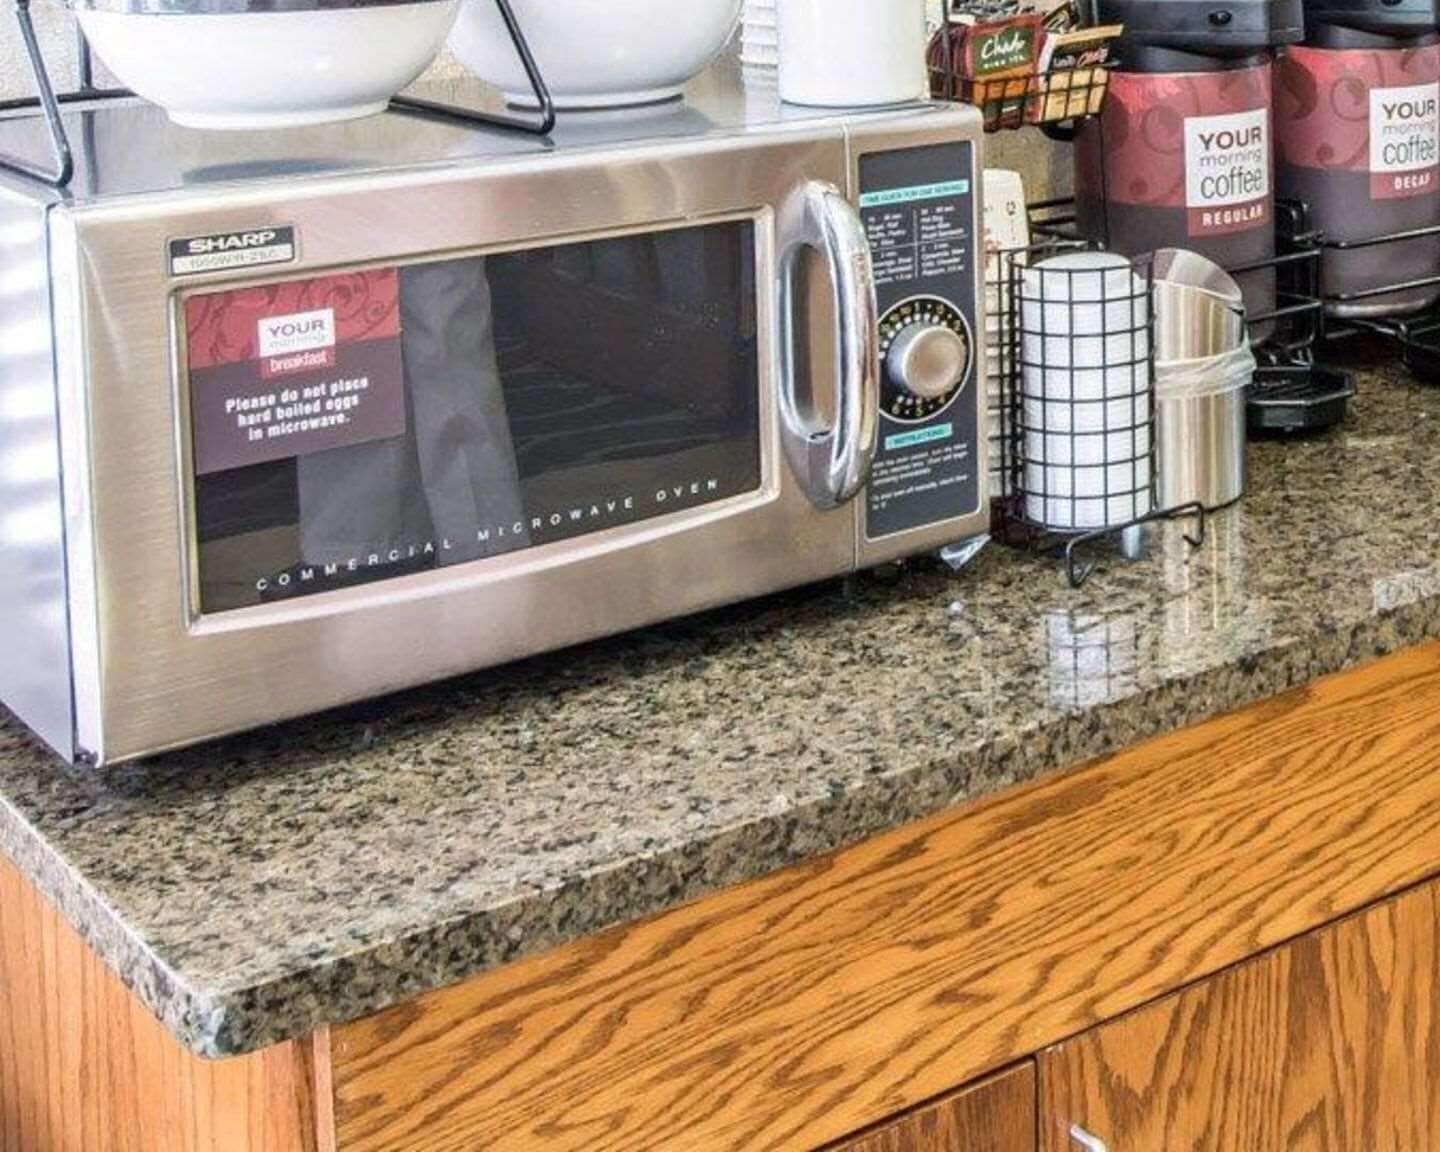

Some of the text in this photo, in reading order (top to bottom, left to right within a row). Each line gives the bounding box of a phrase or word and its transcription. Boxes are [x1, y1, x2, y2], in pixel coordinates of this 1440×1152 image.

[1382, 98, 1436, 121] YOUR
[1198, 125, 1262, 151] YOUR
[1382, 119, 1436, 135] morning
[1200, 148, 1262, 167] morning
[1383, 134, 1435, 165] coffee
[1201, 165, 1263, 200] coffee
[1394, 171, 1432, 191] DECAF
[1202, 203, 1263, 226] REGULAR
[188, 230, 277, 254] SHARP
[268, 319, 326, 337] YOUR
[269, 350, 328, 373] breakfast
[225, 377, 369, 414] Please do not place
[238, 394, 360, 428] hard boiled eggs
[248, 411, 351, 442] in microwave.
[255, 477, 721, 593] COMMERCIAL MICROWAVE OVEN
